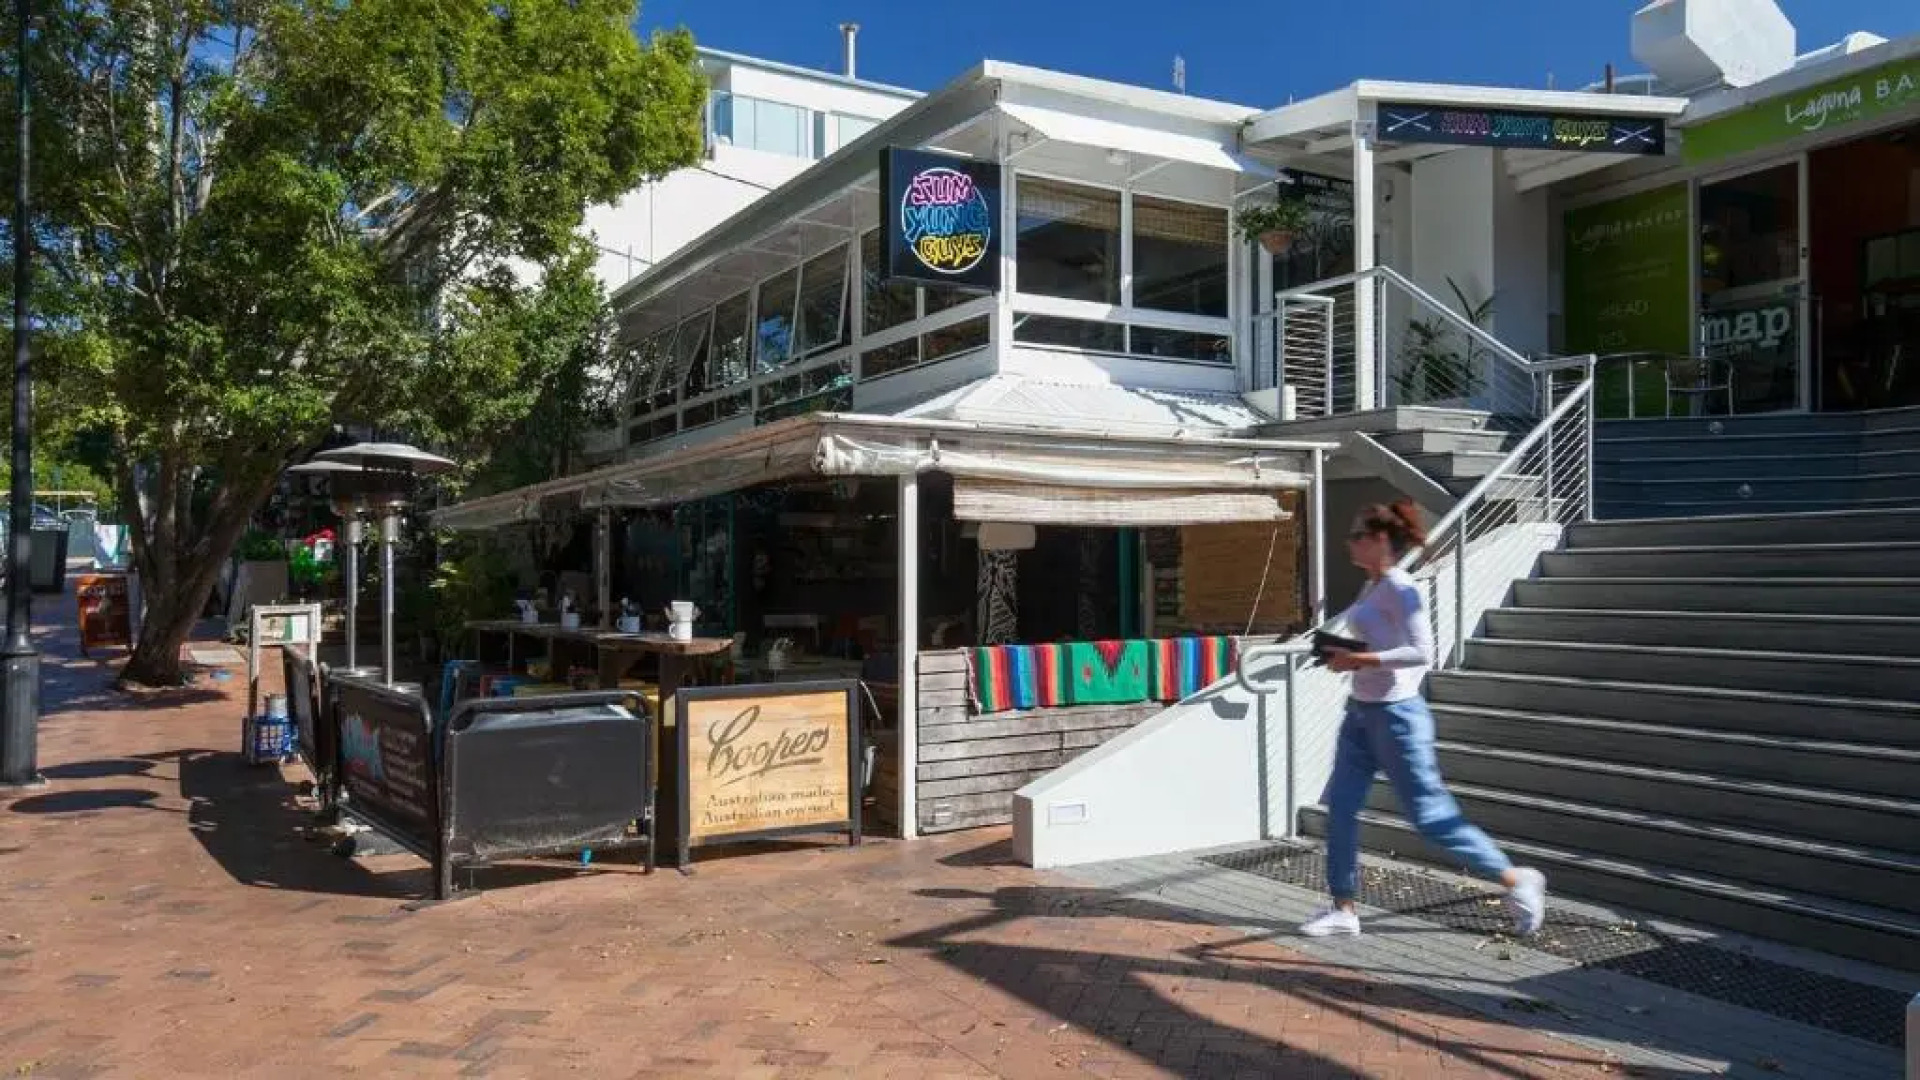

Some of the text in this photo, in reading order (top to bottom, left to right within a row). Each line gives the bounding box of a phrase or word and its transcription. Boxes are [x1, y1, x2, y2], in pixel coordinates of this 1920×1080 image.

[911, 173, 975, 205] SUM
[905, 200, 988, 242] YUNG
[1702, 306, 1790, 348] map
[706, 704, 830, 780] Coopers
[702, 808, 782, 826] Australian
[706, 789, 786, 808] Australian
